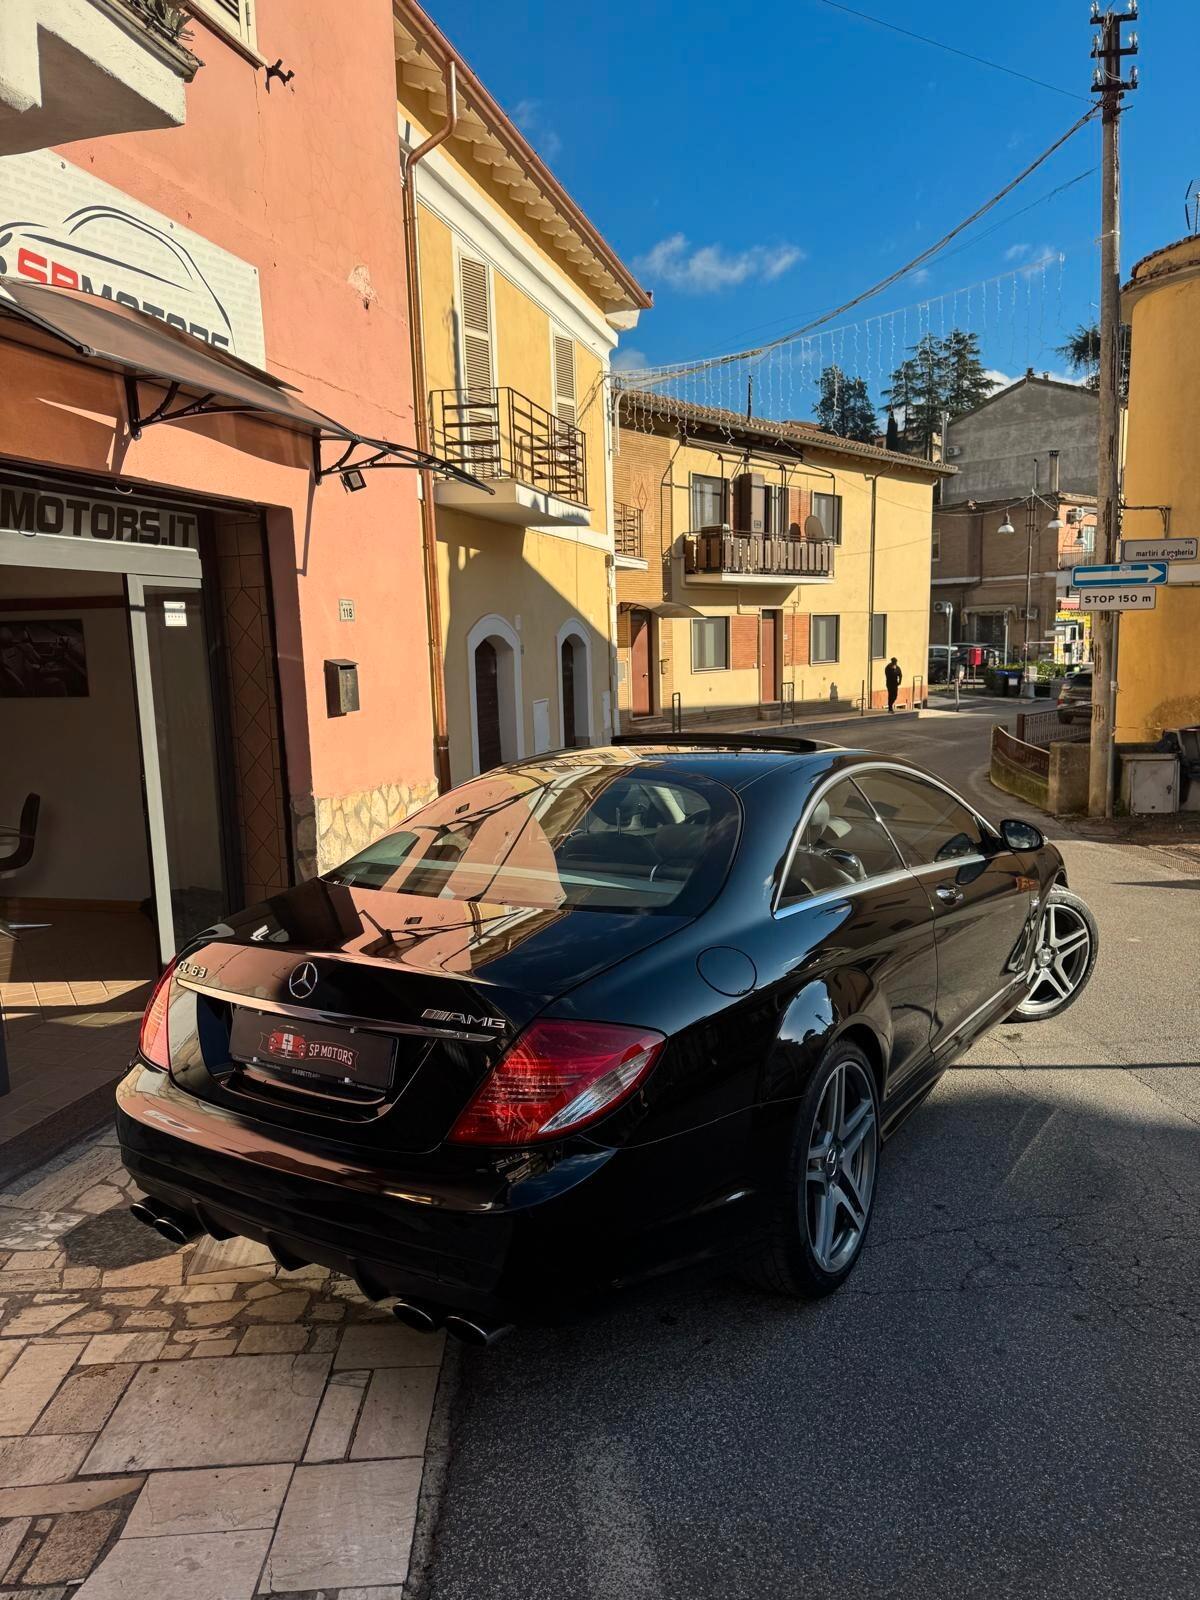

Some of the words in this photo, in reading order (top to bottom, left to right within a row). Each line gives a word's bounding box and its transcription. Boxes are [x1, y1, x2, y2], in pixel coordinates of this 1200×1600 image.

[1135, 549, 1159, 557] martiri
[1084, 595, 1116, 604] STOP
[1119, 594, 1138, 602] 150
[343, 607, 353, 618] 118
[178, 960, 189, 973] CL
[191, 965, 208, 978] 63
[445, 1011, 506, 1029] AMG
[308, 1043, 320, 1057] SP
[320, 1045, 354, 1065] MOTORS
